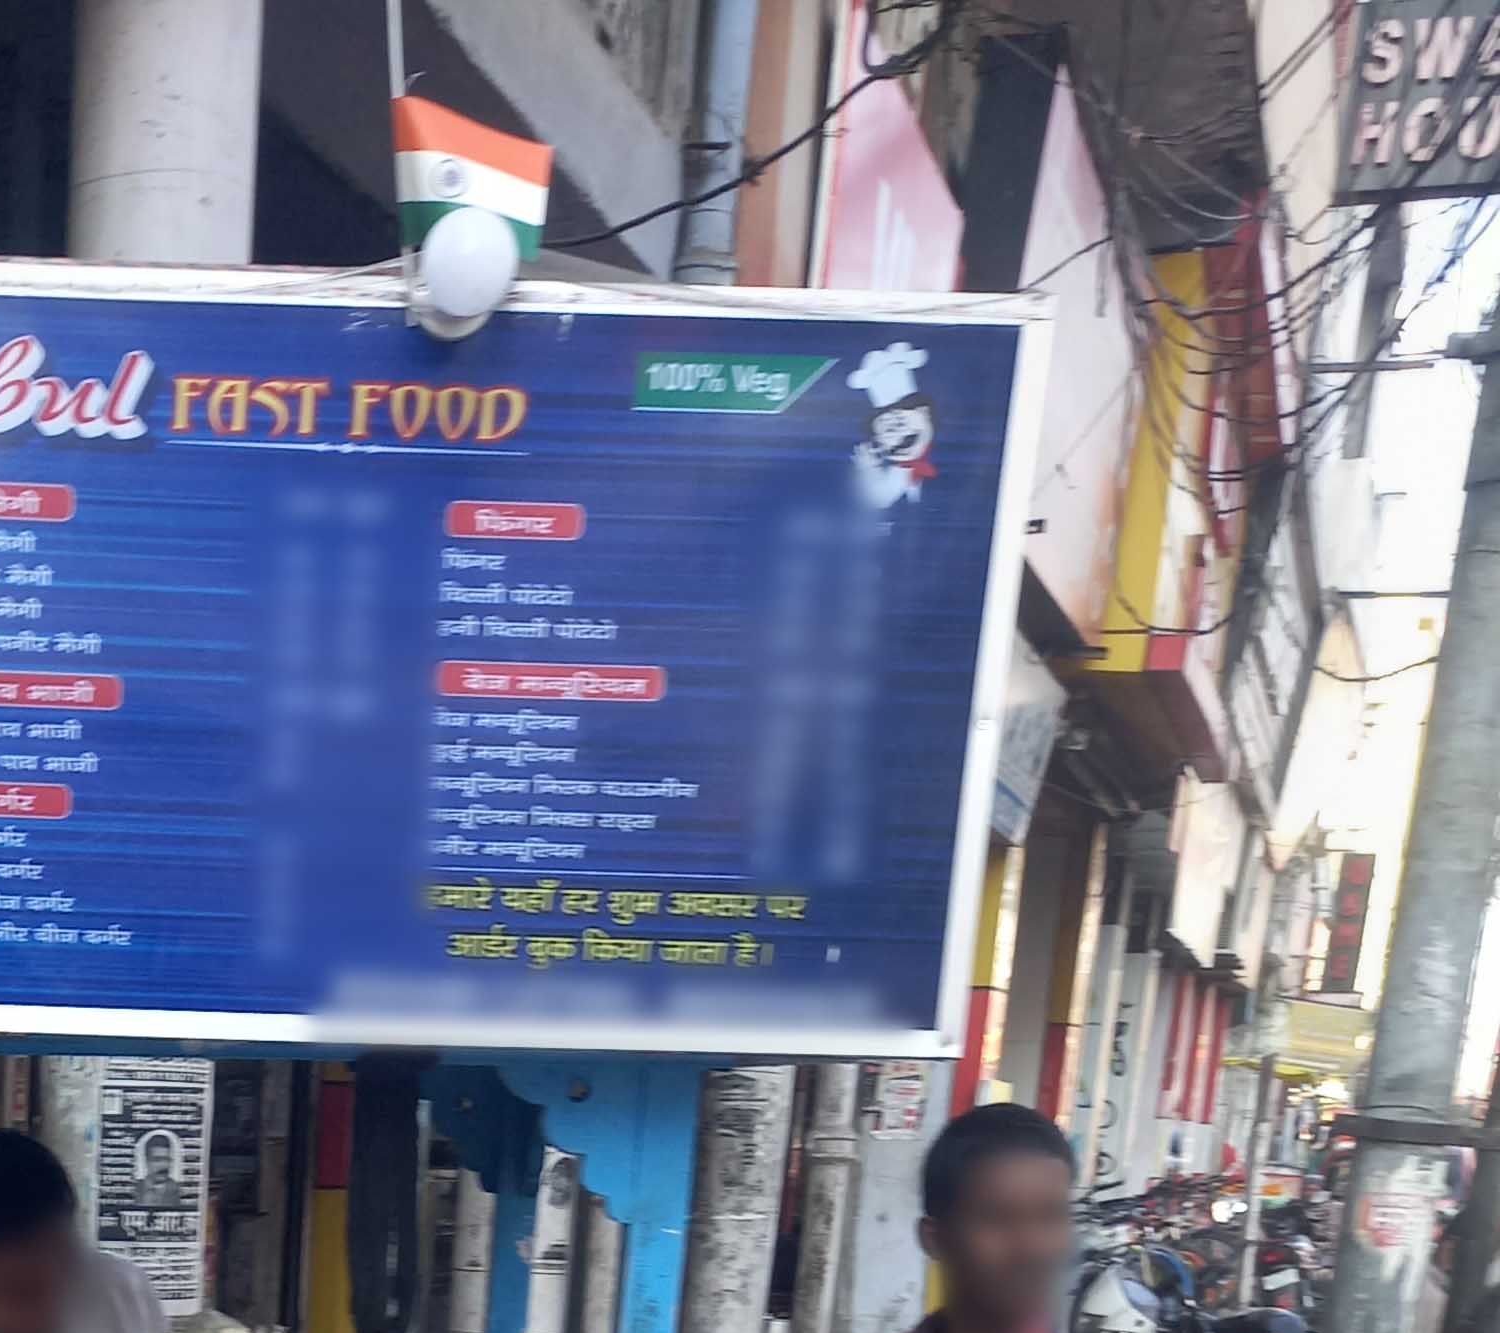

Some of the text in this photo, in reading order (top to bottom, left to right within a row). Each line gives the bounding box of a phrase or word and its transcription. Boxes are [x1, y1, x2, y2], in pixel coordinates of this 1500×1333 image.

[645, 363, 790, 400] 100% Veg
[168, 374, 329, 436] FAST
[346, 382, 528, 443] FOOD
[560, 889, 603, 915] हर
[763, 894, 809, 920] पर
